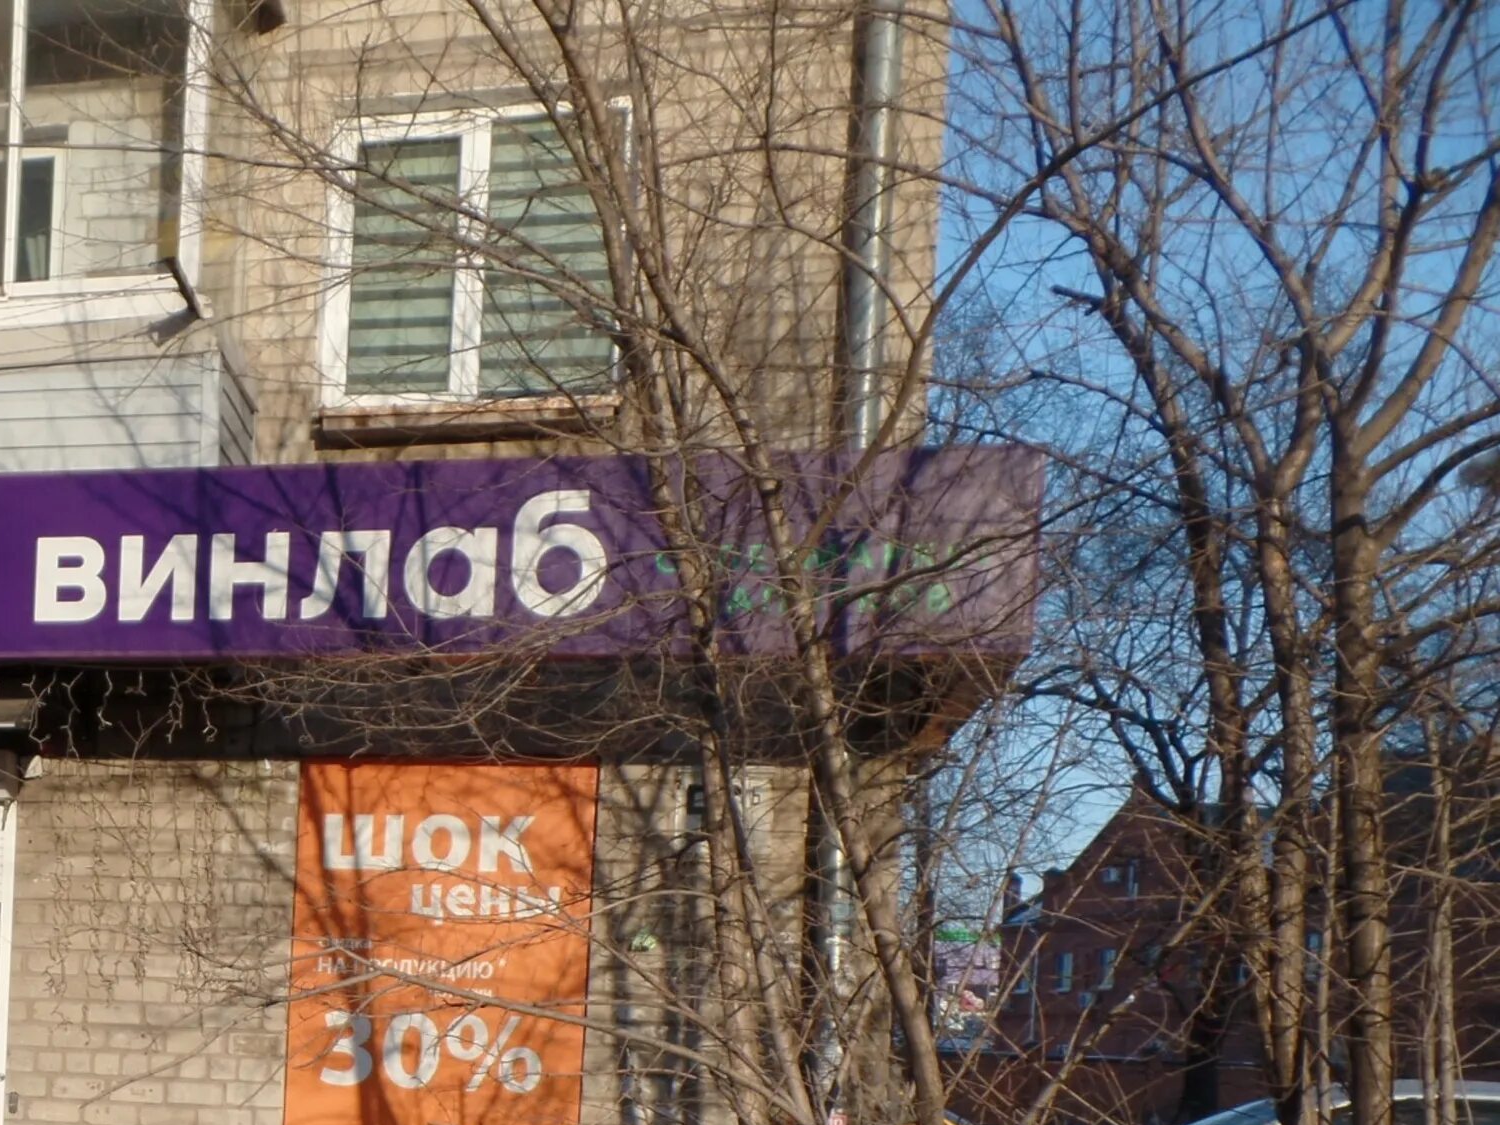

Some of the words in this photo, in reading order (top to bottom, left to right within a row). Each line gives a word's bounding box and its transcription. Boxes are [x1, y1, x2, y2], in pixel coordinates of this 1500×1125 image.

[33, 489, 608, 623] винлаб
[322, 813, 536, 874] ШОК
[410, 884, 562, 926] цены
[319, 1009, 543, 1094] 30%
